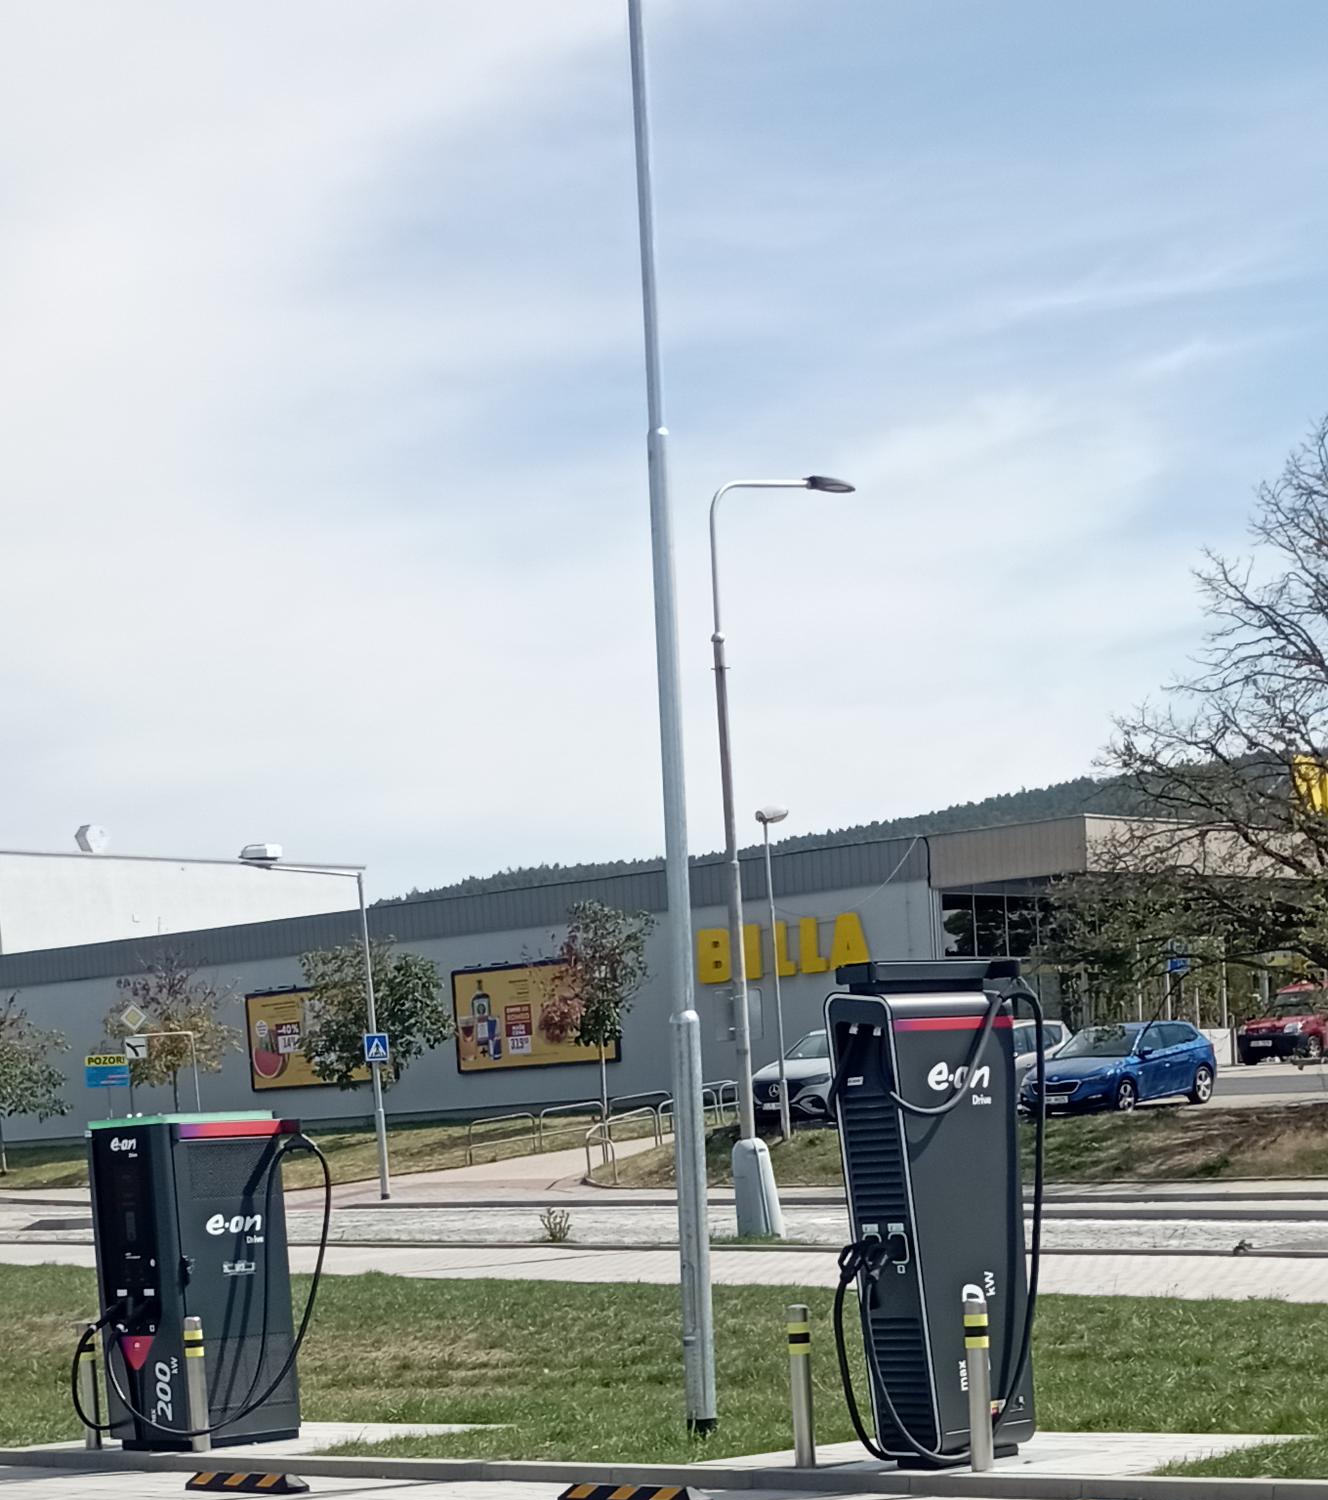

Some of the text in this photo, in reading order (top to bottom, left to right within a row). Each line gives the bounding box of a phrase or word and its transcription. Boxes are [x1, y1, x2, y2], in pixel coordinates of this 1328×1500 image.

[697, 912, 871, 985] BILLA
[972, 1094, 992, 1105] Drive
[983, 1271, 996, 1297] kW
[155, 1361, 173, 1422] 200
[958, 1360, 969, 1392] max
